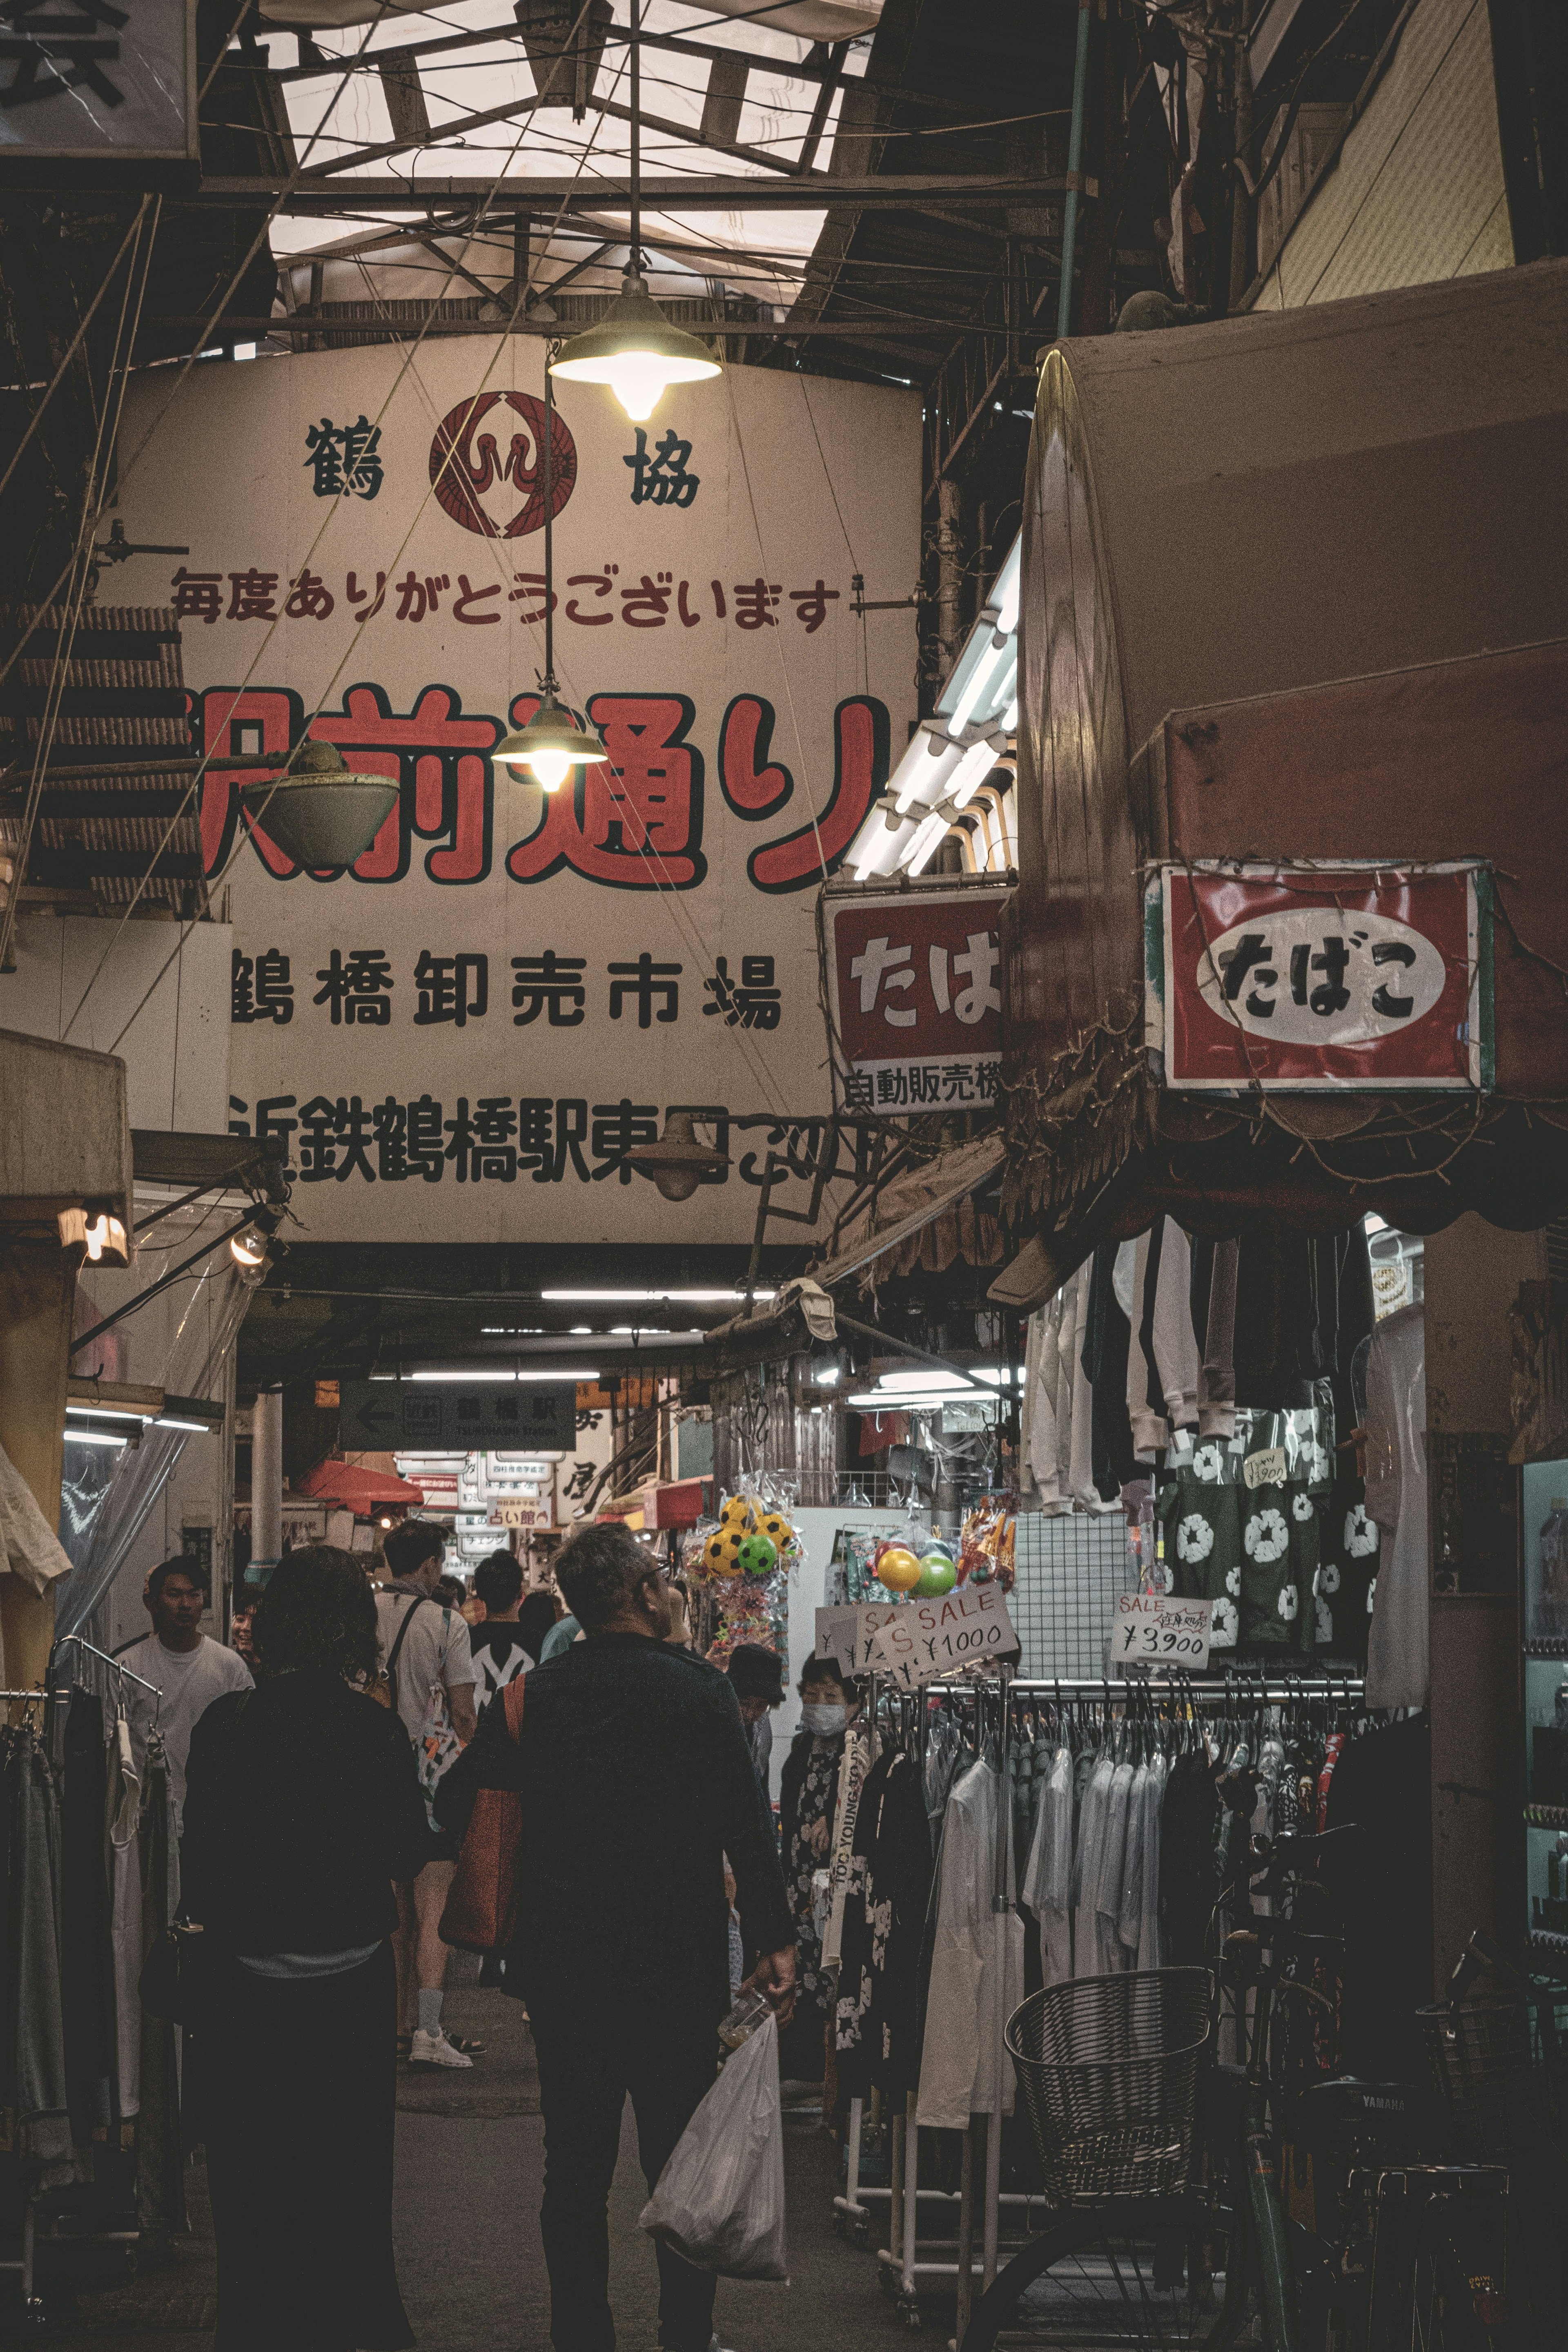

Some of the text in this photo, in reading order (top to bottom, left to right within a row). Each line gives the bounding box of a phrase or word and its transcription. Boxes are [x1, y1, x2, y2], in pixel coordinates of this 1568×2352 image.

[303, 415, 700, 508] 鶴 協
[171, 564, 840, 633] 毎度ありがとうございます
[232, 947, 782, 1030] 鶴橋卸売市場
[1218, 931, 1417, 1018] たばこ
[490, 1509, 535, 1525] 占い館
[919, 1592, 995, 1630] SALE
[1119, 1596, 1165, 1613] SALE
[840, 1790, 858, 1848] YOUNG
[1363, 2095, 1405, 2111] YAMAHA
